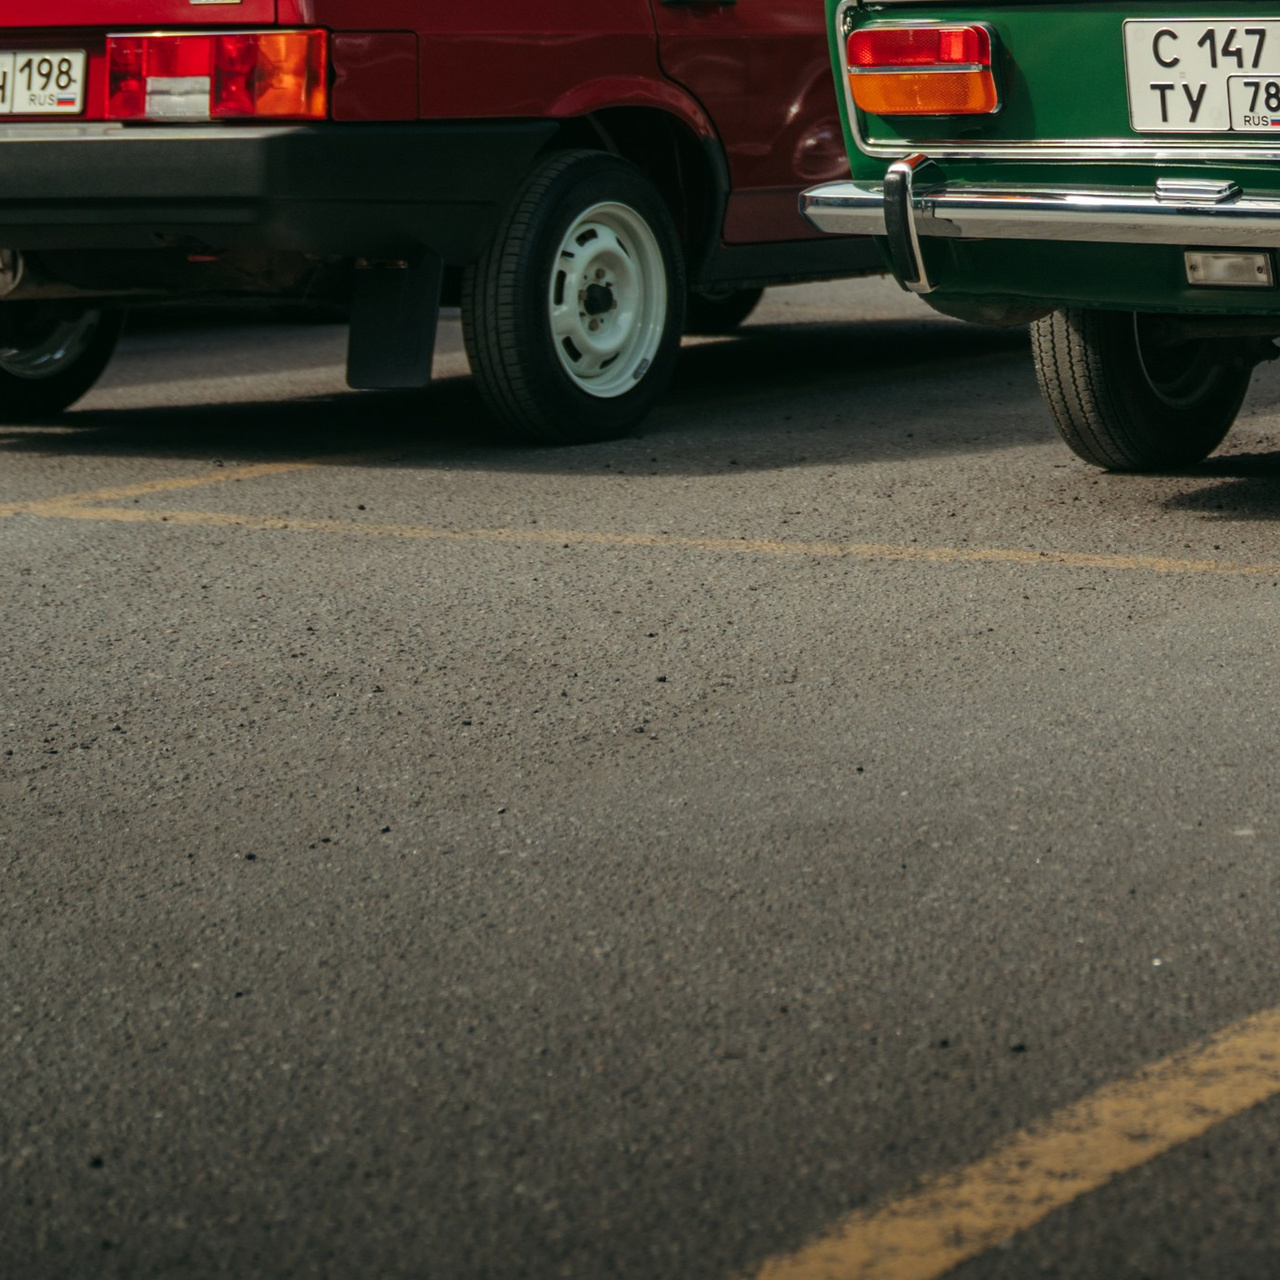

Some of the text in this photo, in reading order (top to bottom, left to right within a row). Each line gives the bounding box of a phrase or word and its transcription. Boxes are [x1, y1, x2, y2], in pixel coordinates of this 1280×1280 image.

[1197, 28, 1266, 69] 147
[19, 57, 72, 91] 198
[29, 93, 56, 106] RUS
[1243, 115, 1270, 126] RUS
